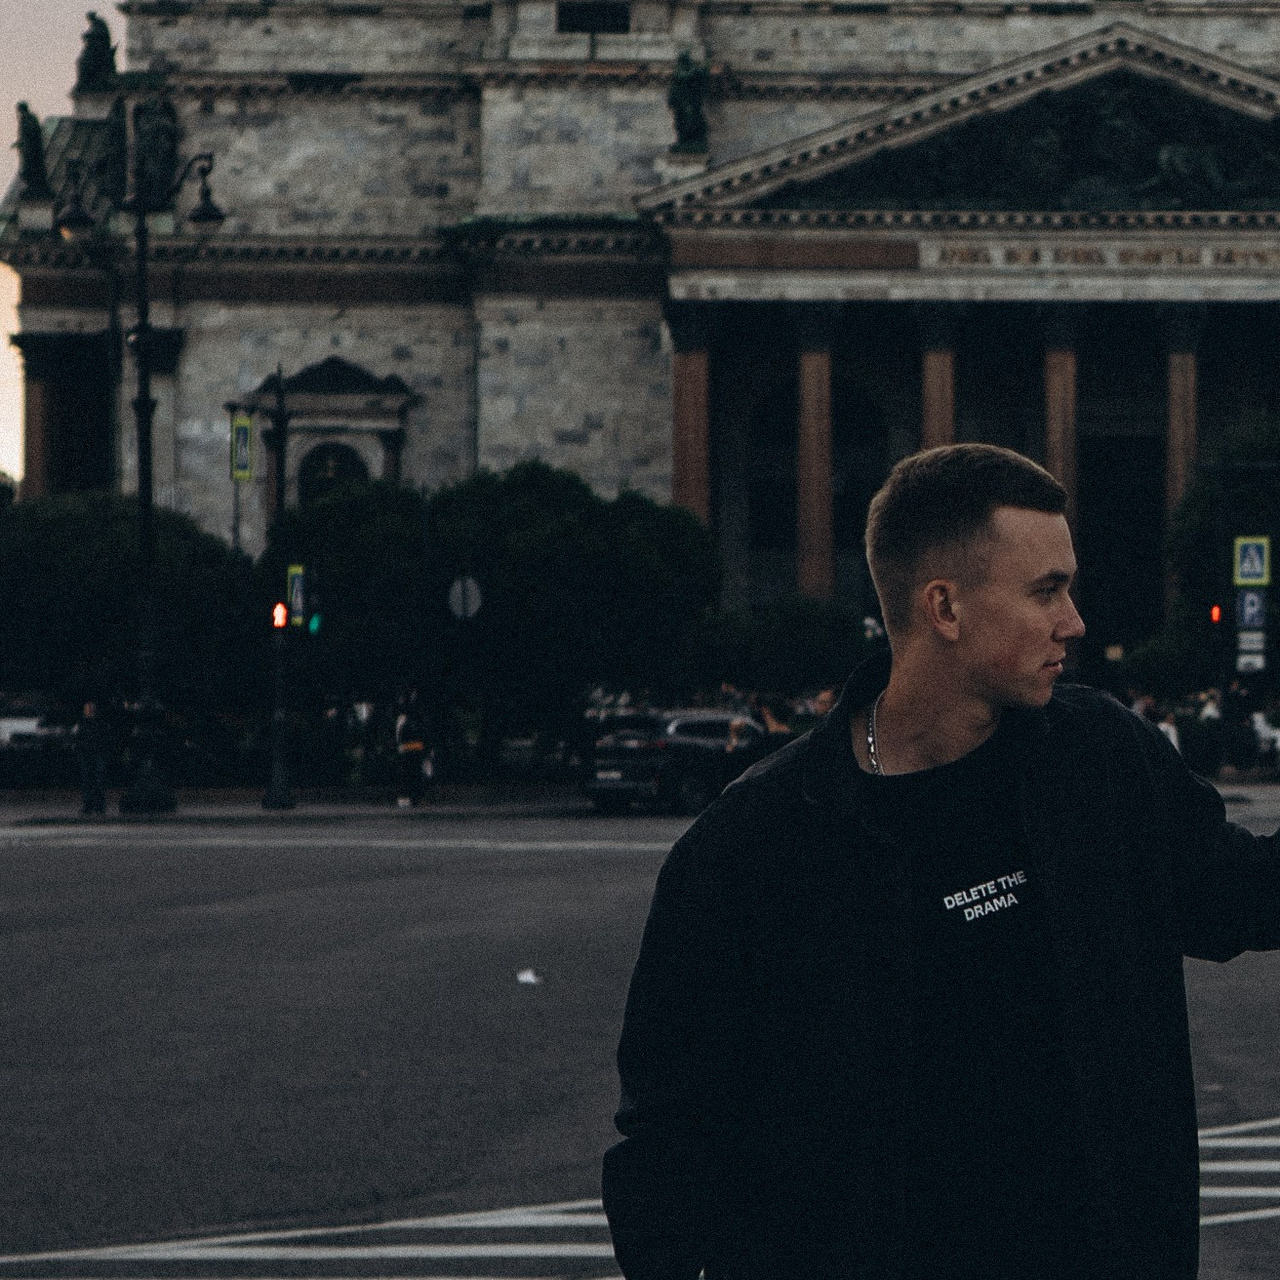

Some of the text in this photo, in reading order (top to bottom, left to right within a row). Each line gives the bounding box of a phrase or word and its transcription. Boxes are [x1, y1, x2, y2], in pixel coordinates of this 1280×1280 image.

[944, 871, 1027, 910] DELETE THE
[963, 893, 1018, 921] DRAMA
